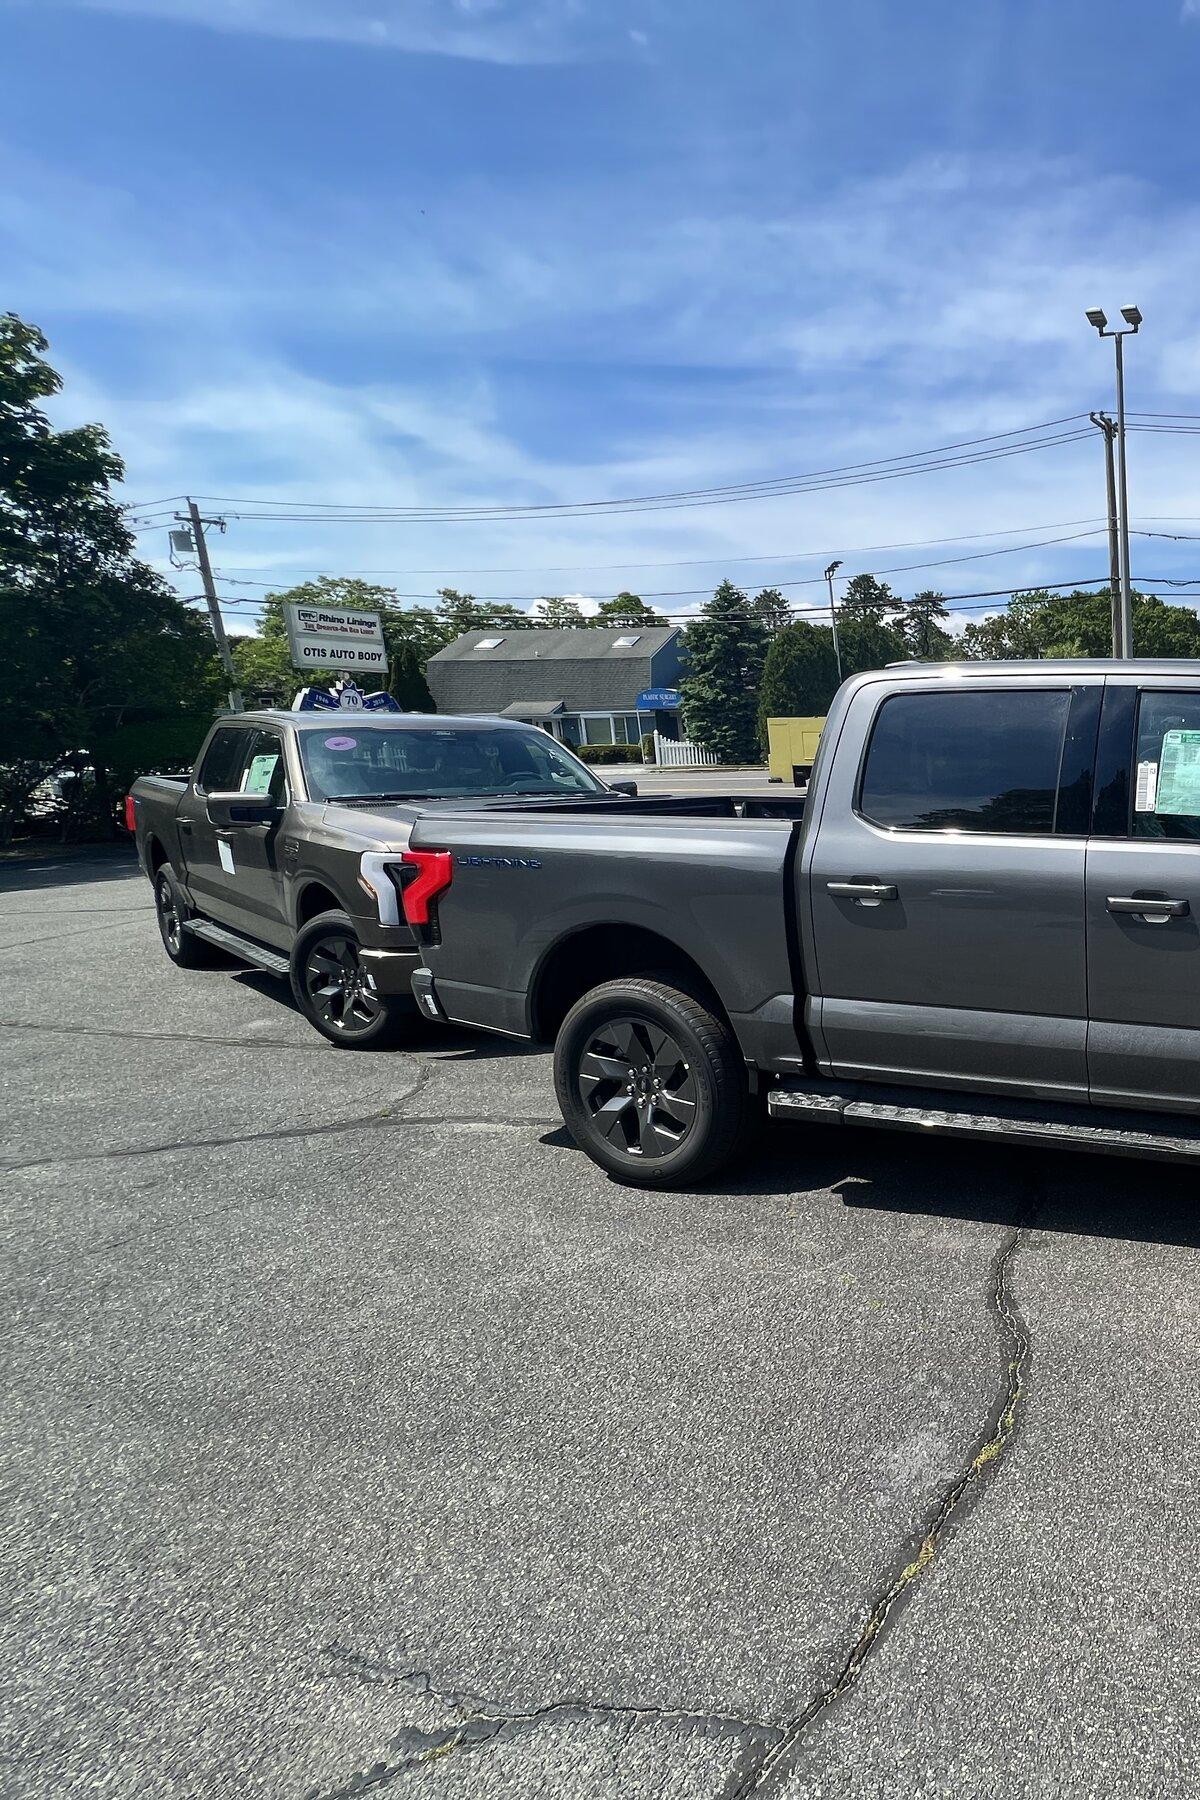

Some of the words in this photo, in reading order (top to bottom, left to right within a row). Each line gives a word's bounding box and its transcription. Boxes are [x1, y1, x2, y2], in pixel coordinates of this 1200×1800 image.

[319, 614, 345, 624] Rhino
[347, 617, 377, 628] Linings
[304, 647, 327, 658] OTIS
[330, 649, 355, 659] AUTO
[358, 652, 382, 661] BODY
[344, 696, 358, 706] 70
[457, 856, 542, 869] LIGHTNING
